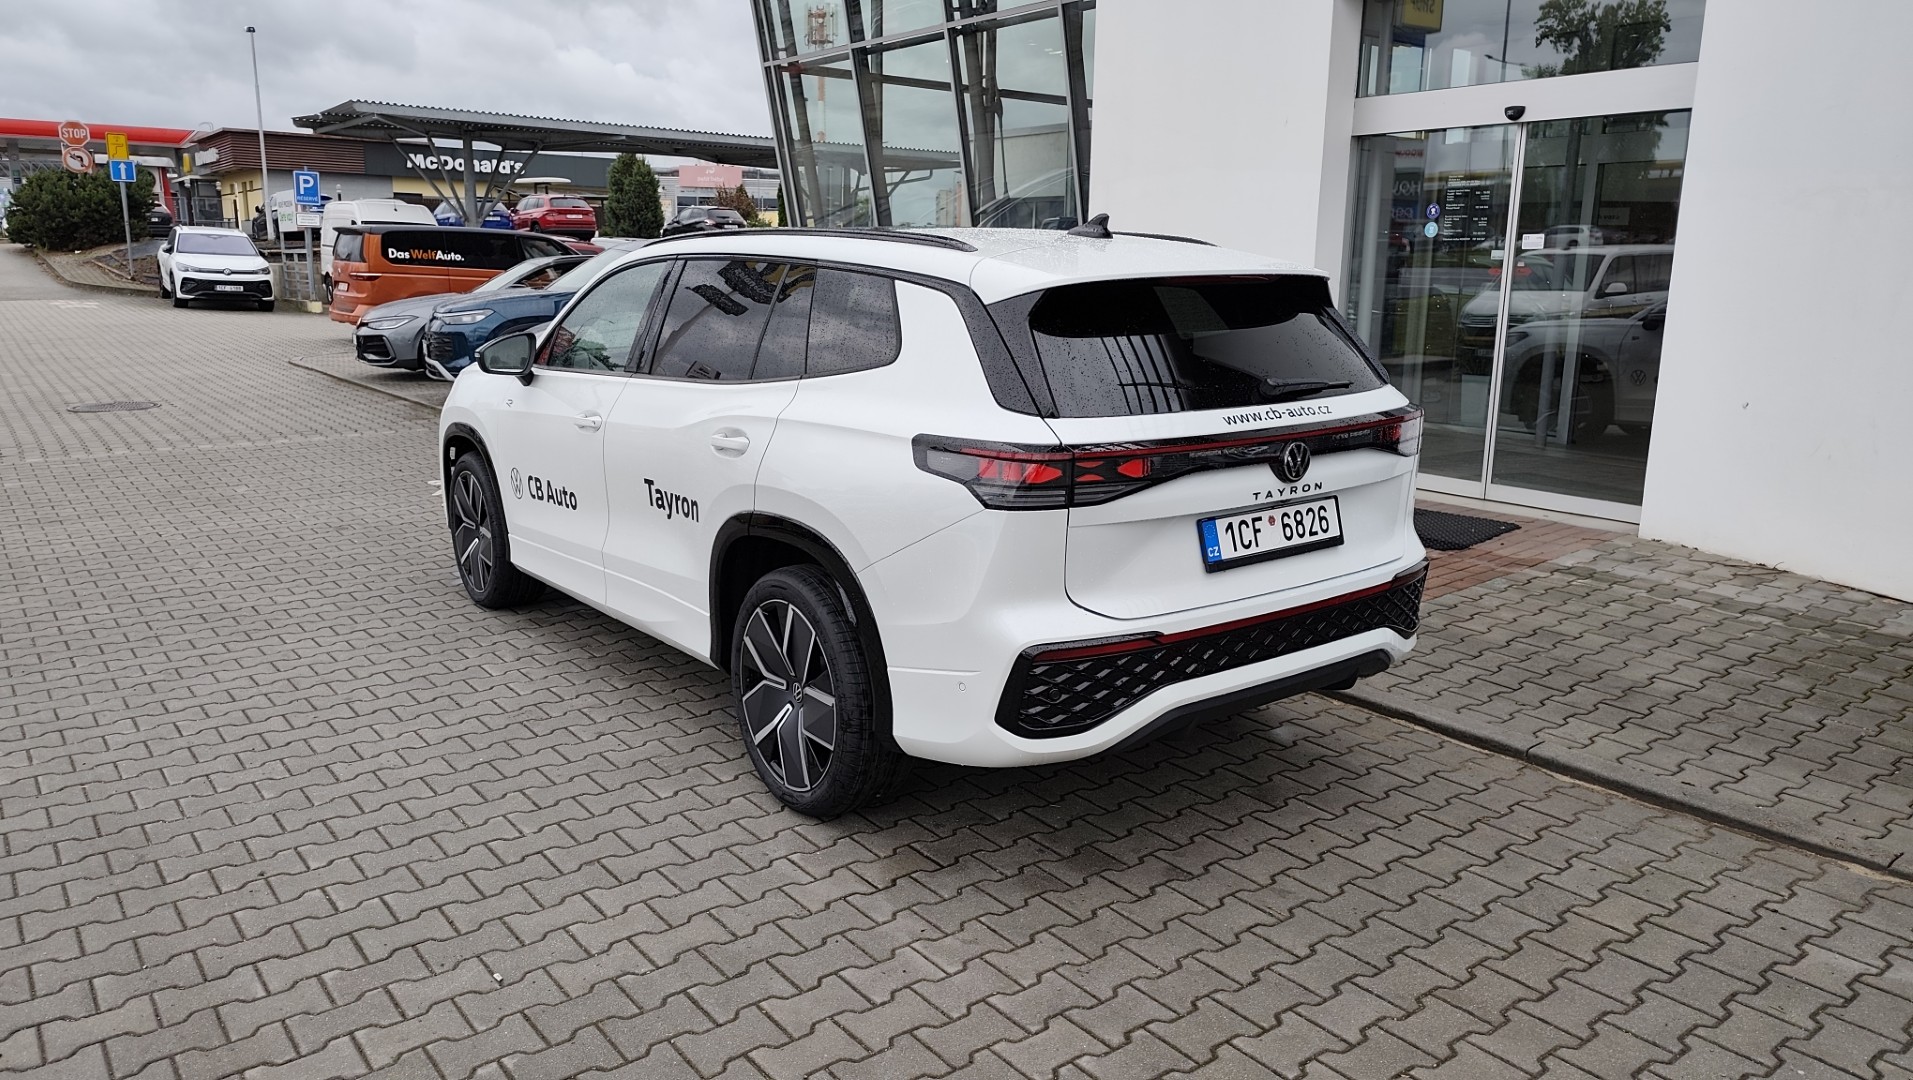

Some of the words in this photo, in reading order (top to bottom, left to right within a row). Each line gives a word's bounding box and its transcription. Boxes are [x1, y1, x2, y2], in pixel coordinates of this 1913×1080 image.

[62, 128, 87, 139] STOP
[406, 153, 525, 175] McDonald's
[299, 175, 314, 195] P
[388, 248, 410, 259] Das
[1222, 405, 1333, 426] www.cb-auto.cz
[527, 475, 545, 501] CB
[547, 480, 578, 511] Auto
[643, 478, 699, 523] Tayron
[1252, 481, 1323, 501] TAYRON
[1207, 546, 1220, 558] CZ
[1225, 516, 1263, 552] 1CF
[1281, 505, 1330, 541] 6826
